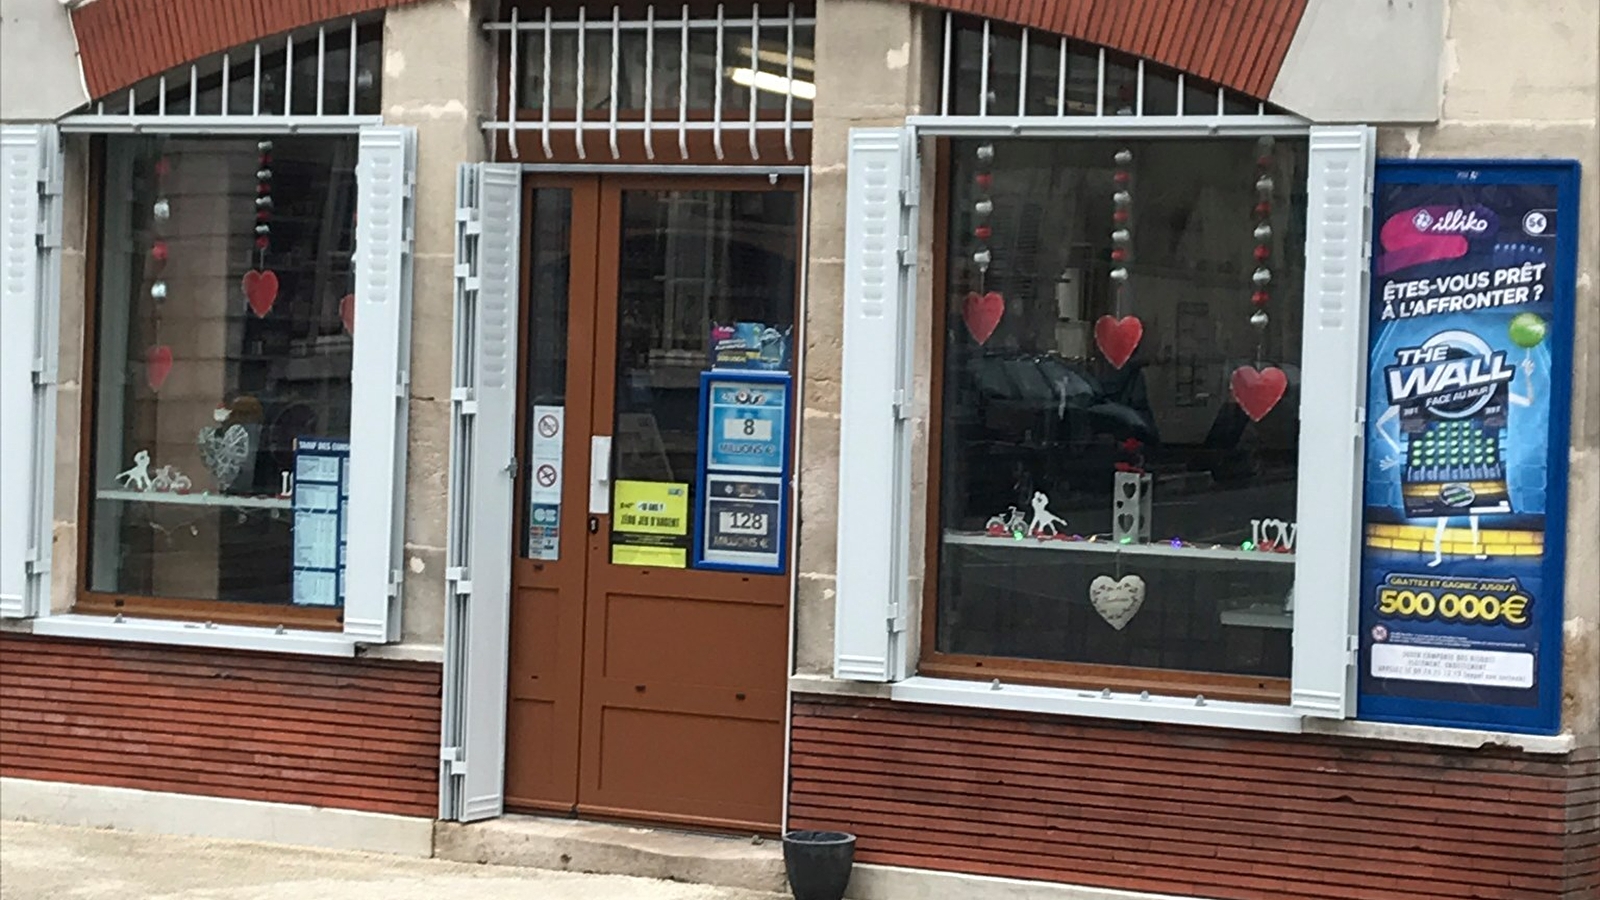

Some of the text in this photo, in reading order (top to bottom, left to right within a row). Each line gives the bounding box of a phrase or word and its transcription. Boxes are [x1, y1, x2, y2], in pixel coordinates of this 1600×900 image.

[1432, 209, 1488, 231] illiko
[1528, 217, 1545, 227] 5€
[1384, 262, 1546, 301] ÊTES-VOUS PRÊT
[1382, 285, 1544, 320] À L'AFFRONTER ?
[1398, 345, 1449, 366] THE
[1389, 355, 1513, 400] WALL
[1426, 386, 1489, 406] FACE AU MUR
[743, 419, 755, 436] 8
[730, 512, 763, 529] 128
[1390, 577, 1429, 587] GRATTEZ
[1430, 579, 1441, 588] ET
[1441, 580, 1477, 591] GAGNEZ
[1380, 590, 1528, 624] 500 000€
